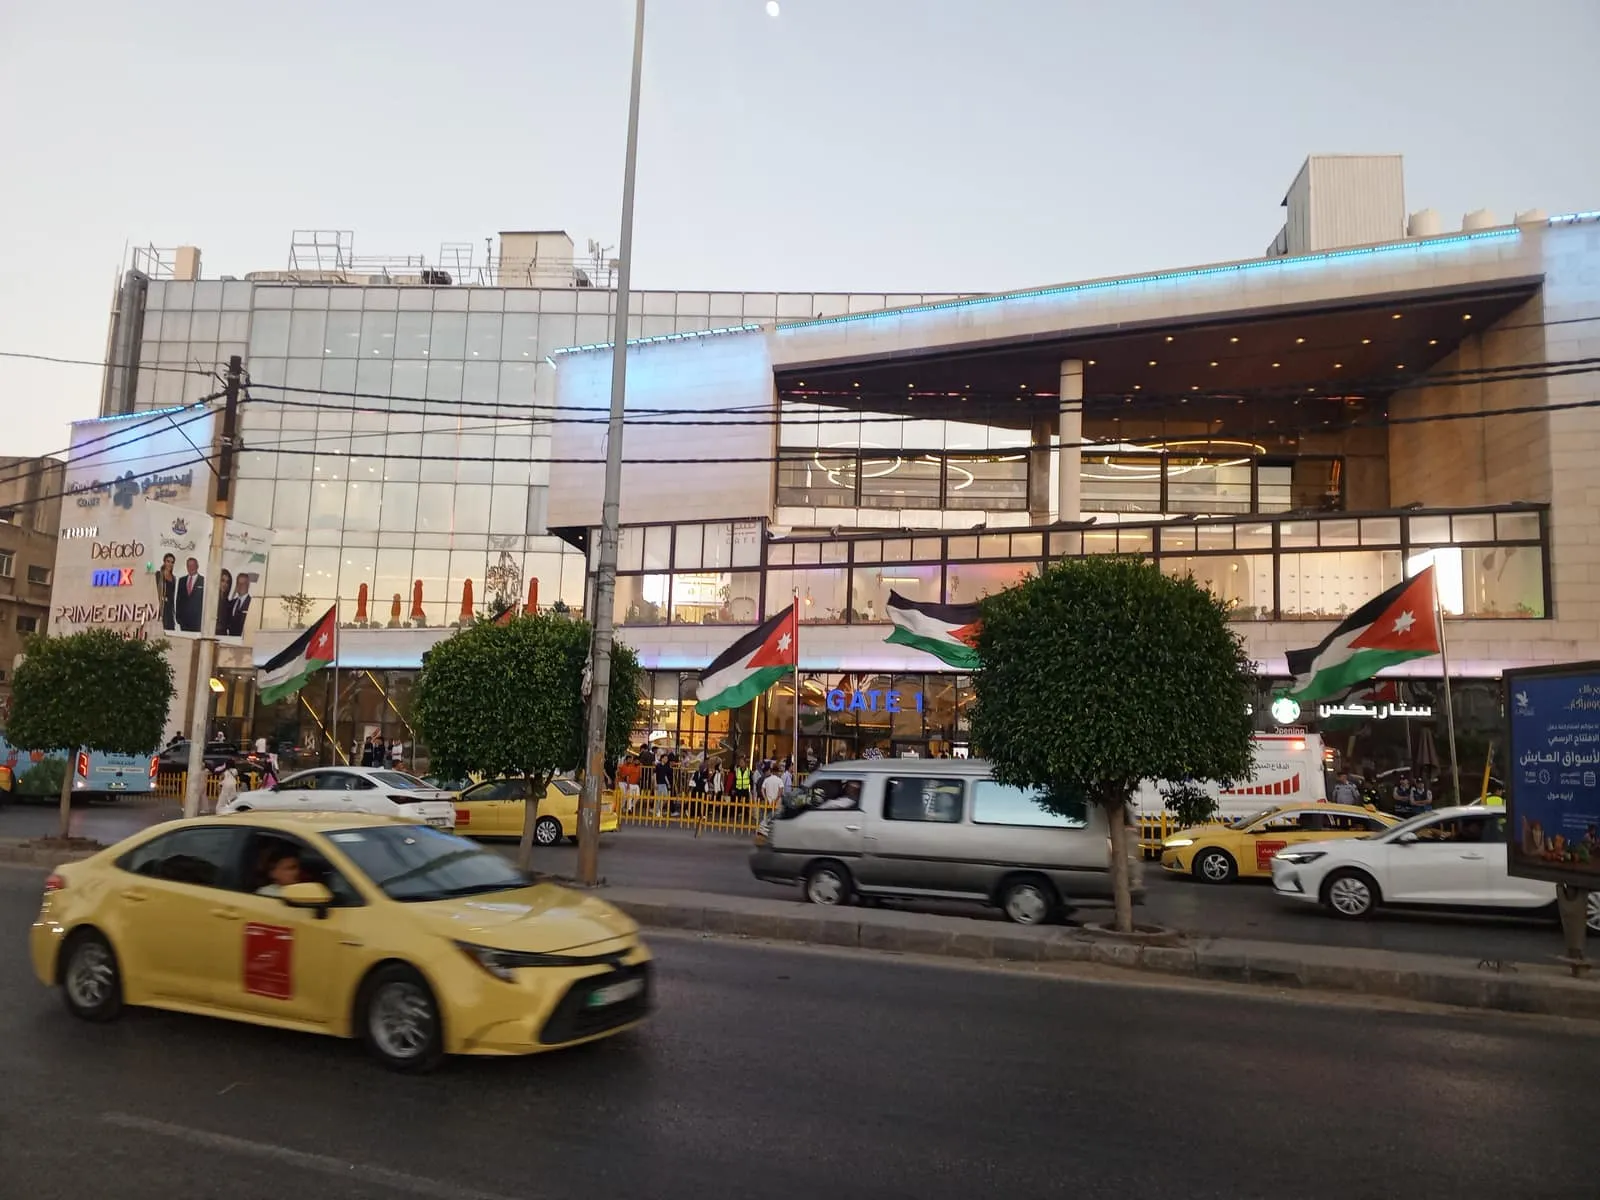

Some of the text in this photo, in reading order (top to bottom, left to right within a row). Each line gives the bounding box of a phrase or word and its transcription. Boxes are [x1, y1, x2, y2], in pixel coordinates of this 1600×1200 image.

[91, 538, 144, 560] DeFacto
[92, 567, 134, 587] max
[55, 602, 160, 624] PRIME CINEM
[827, 689, 924, 713] GATE 1
[1319, 702, 1431, 719] ستاربكس
